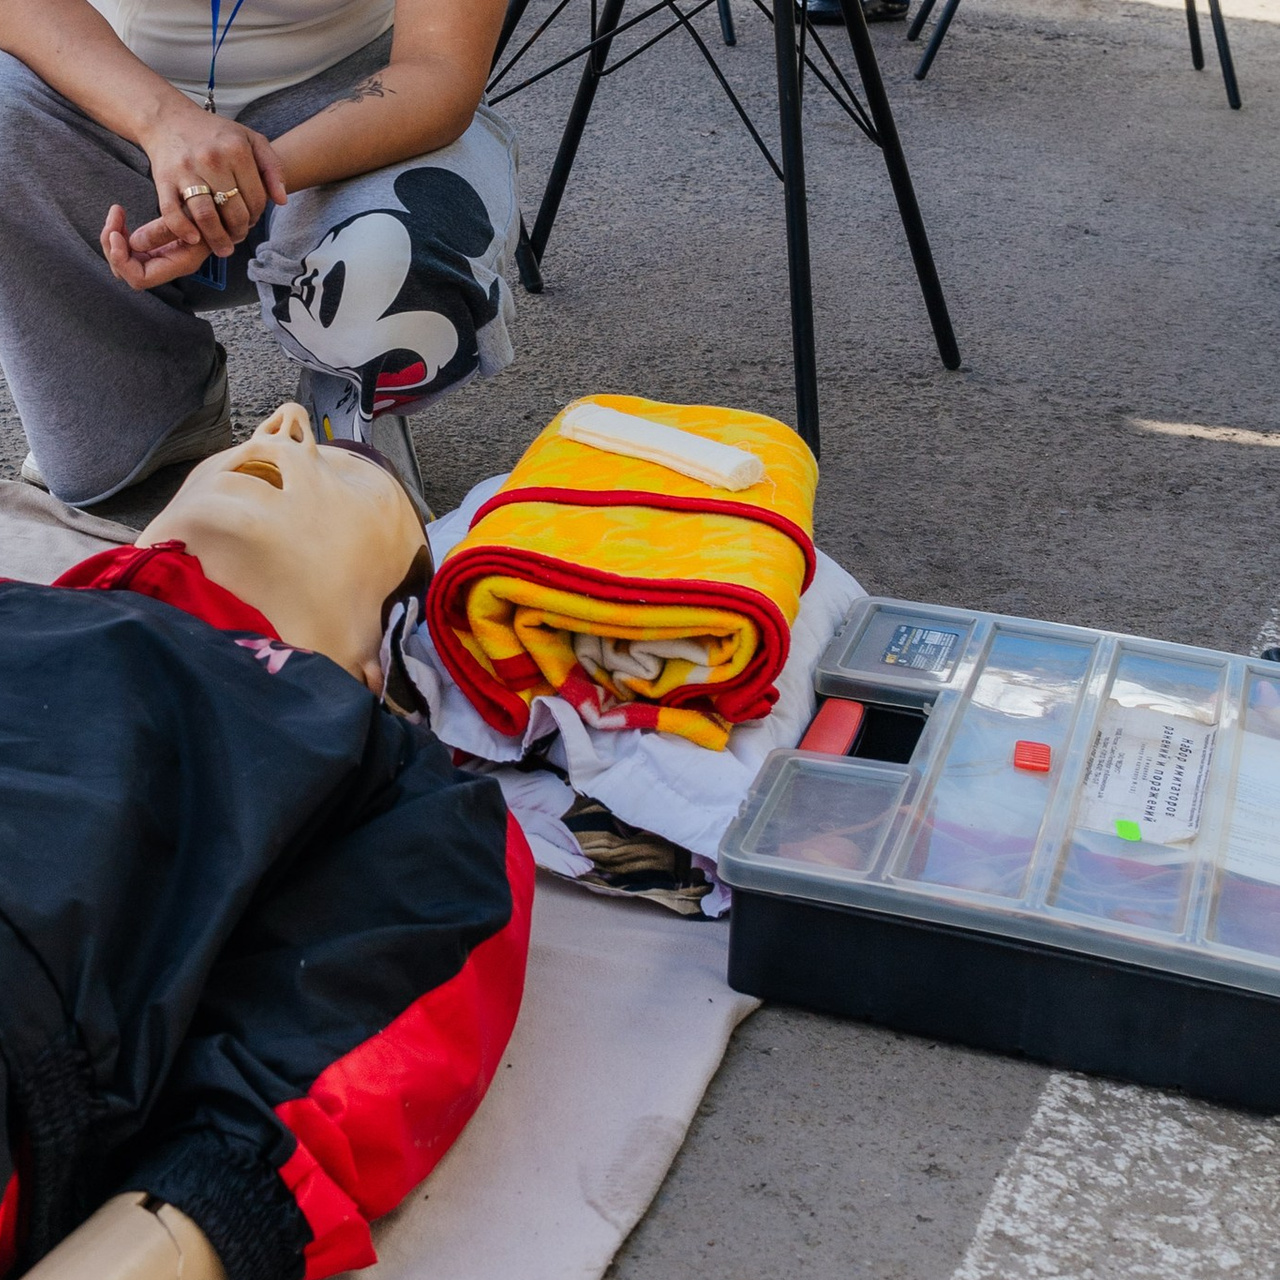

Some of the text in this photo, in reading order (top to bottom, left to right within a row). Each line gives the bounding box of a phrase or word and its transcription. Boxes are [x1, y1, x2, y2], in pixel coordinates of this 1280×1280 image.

[1158, 725, 1174, 759] ранений
[1143, 769, 1165, 823] поражений
[1165, 737, 1194, 818] Набор имитаторов
